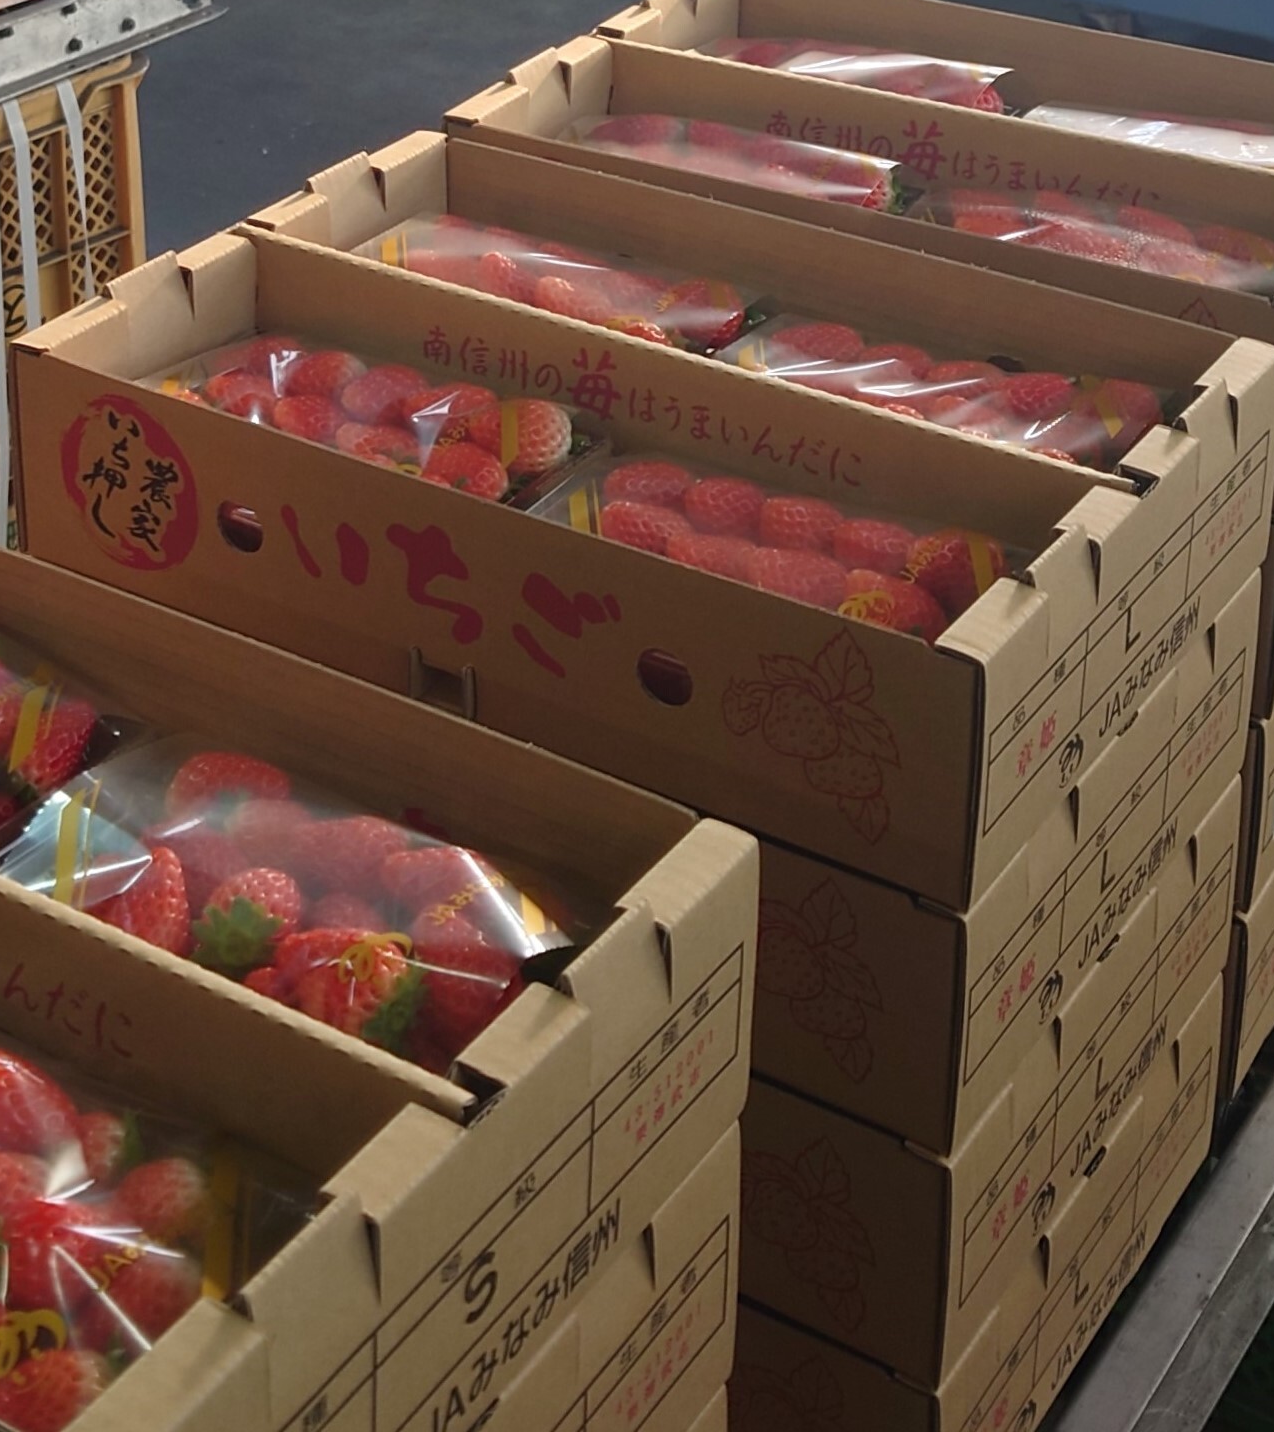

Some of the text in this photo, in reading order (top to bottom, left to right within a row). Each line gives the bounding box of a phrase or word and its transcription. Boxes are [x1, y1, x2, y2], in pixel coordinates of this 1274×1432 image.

[424, 327, 863, 489] 南信州の苺はうまいんだに
[281, 505, 621, 678] いちご
[1125, 606, 1141, 655] L
[1098, 595, 1202, 739] JAみなみ信州
[1078, 822, 1178, 969] JAみなみ信州
[1101, 849, 1116, 894] L
[628, 989, 712, 1089] 生産者
[1069, 1016, 1169, 1179] JAみなみ信州
[1095, 1057, 1110, 1101] L
[431, 1197, 621, 1431] JAみなみ信州
[464, 1249, 498, 1326] S
